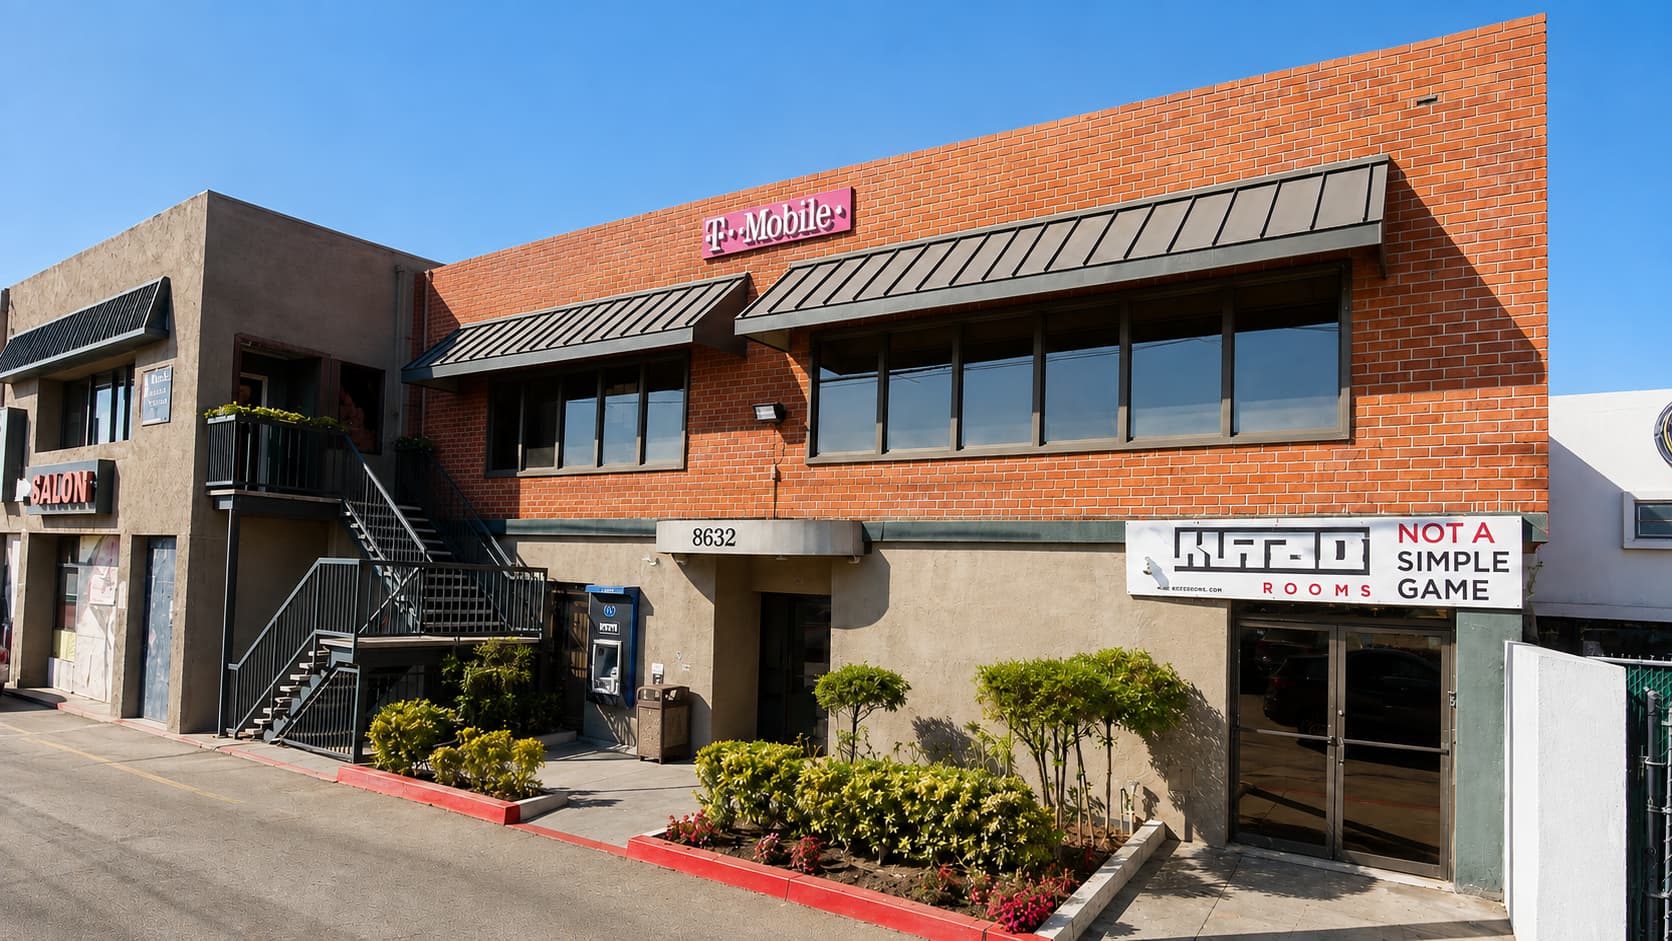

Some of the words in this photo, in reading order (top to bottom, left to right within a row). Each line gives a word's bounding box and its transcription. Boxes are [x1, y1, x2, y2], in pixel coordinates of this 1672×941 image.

[30, 471, 89, 504] SALON
[692, 528, 736, 546] 8632
[1398, 522, 1464, 543] NOT
[1472, 522, 1495, 543] A
[1397, 551, 1510, 573] SIMPLE
[1263, 582, 1371, 597] ROOMS
[1398, 578, 1490, 601] GAME
